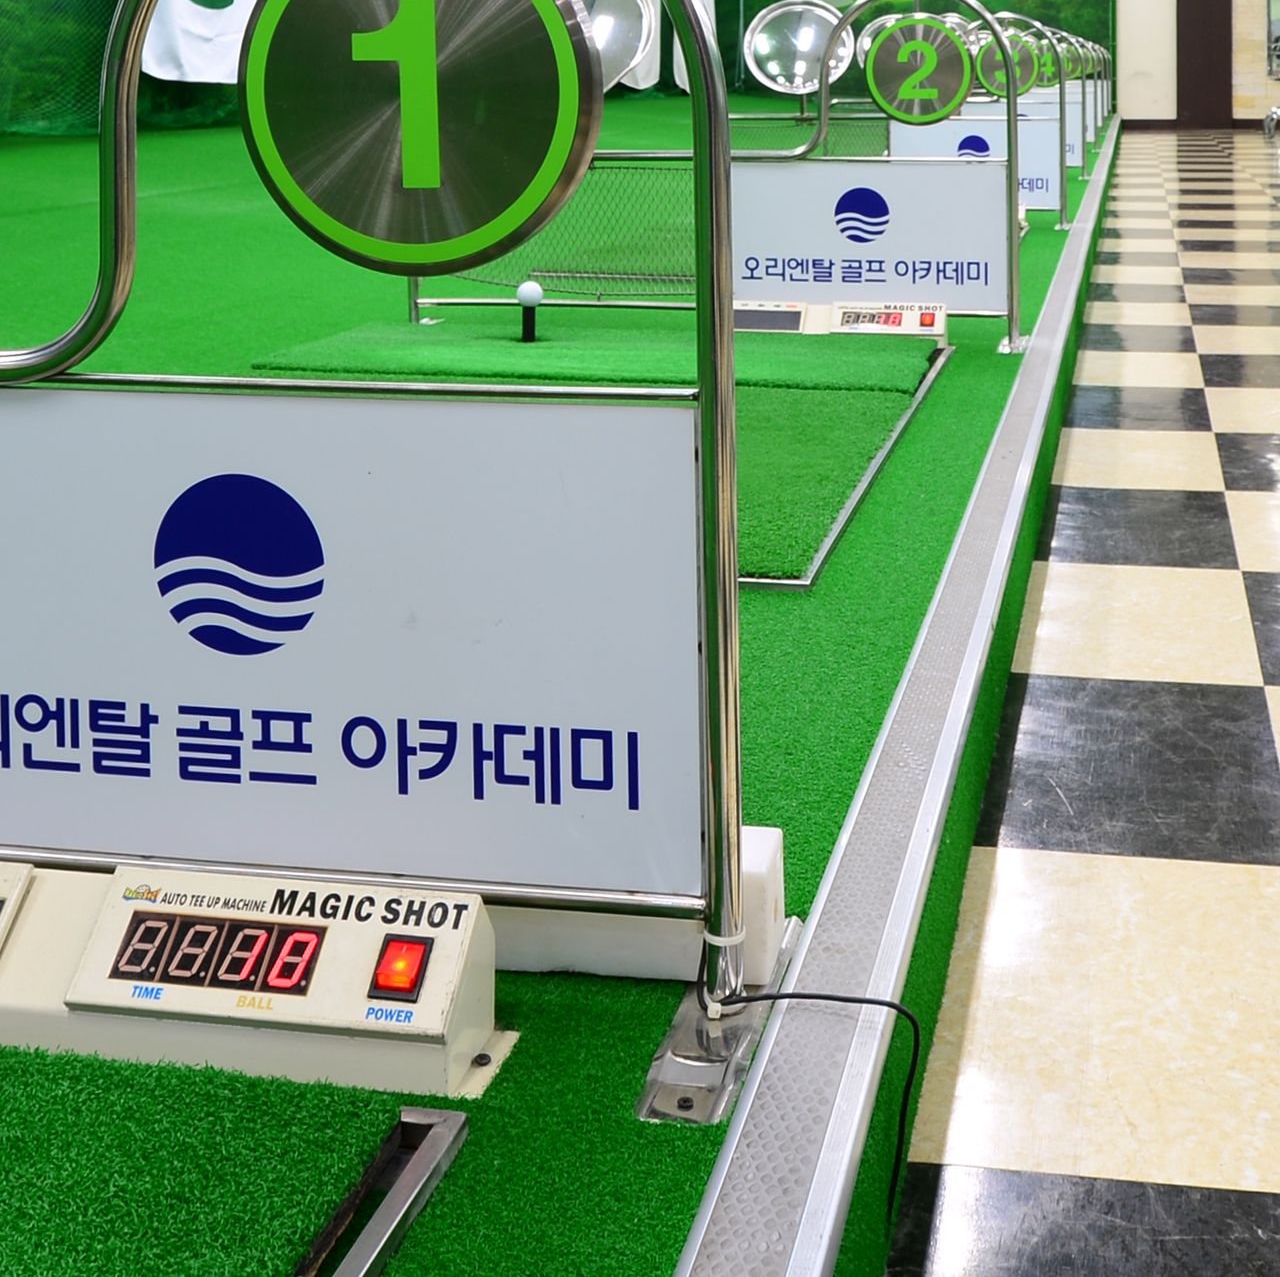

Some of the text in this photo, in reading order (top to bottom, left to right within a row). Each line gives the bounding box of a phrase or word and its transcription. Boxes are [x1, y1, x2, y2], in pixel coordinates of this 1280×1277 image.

[897, 39, 939, 100] 2
[741, 256, 989, 286] 오리엔탈 골프 아카데미
[883, 303, 916, 312] MAGIC
[918, 304, 944, 313] SHOT
[175, 705, 317, 785] 골프
[341, 715, 641, 811] 아카데미
[160, 892, 188, 906] AUTO
[189, 894, 207, 908] TEE
[206, 896, 221, 909] UP
[221, 898, 268, 913] MACHINE
[269, 888, 376, 923] MAGIC
[380, 897, 469, 931] SHOT
[131, 984, 165, 1001] TIME
[236, 994, 274, 1011] BALL
[365, 1006, 414, 1024] POWER
